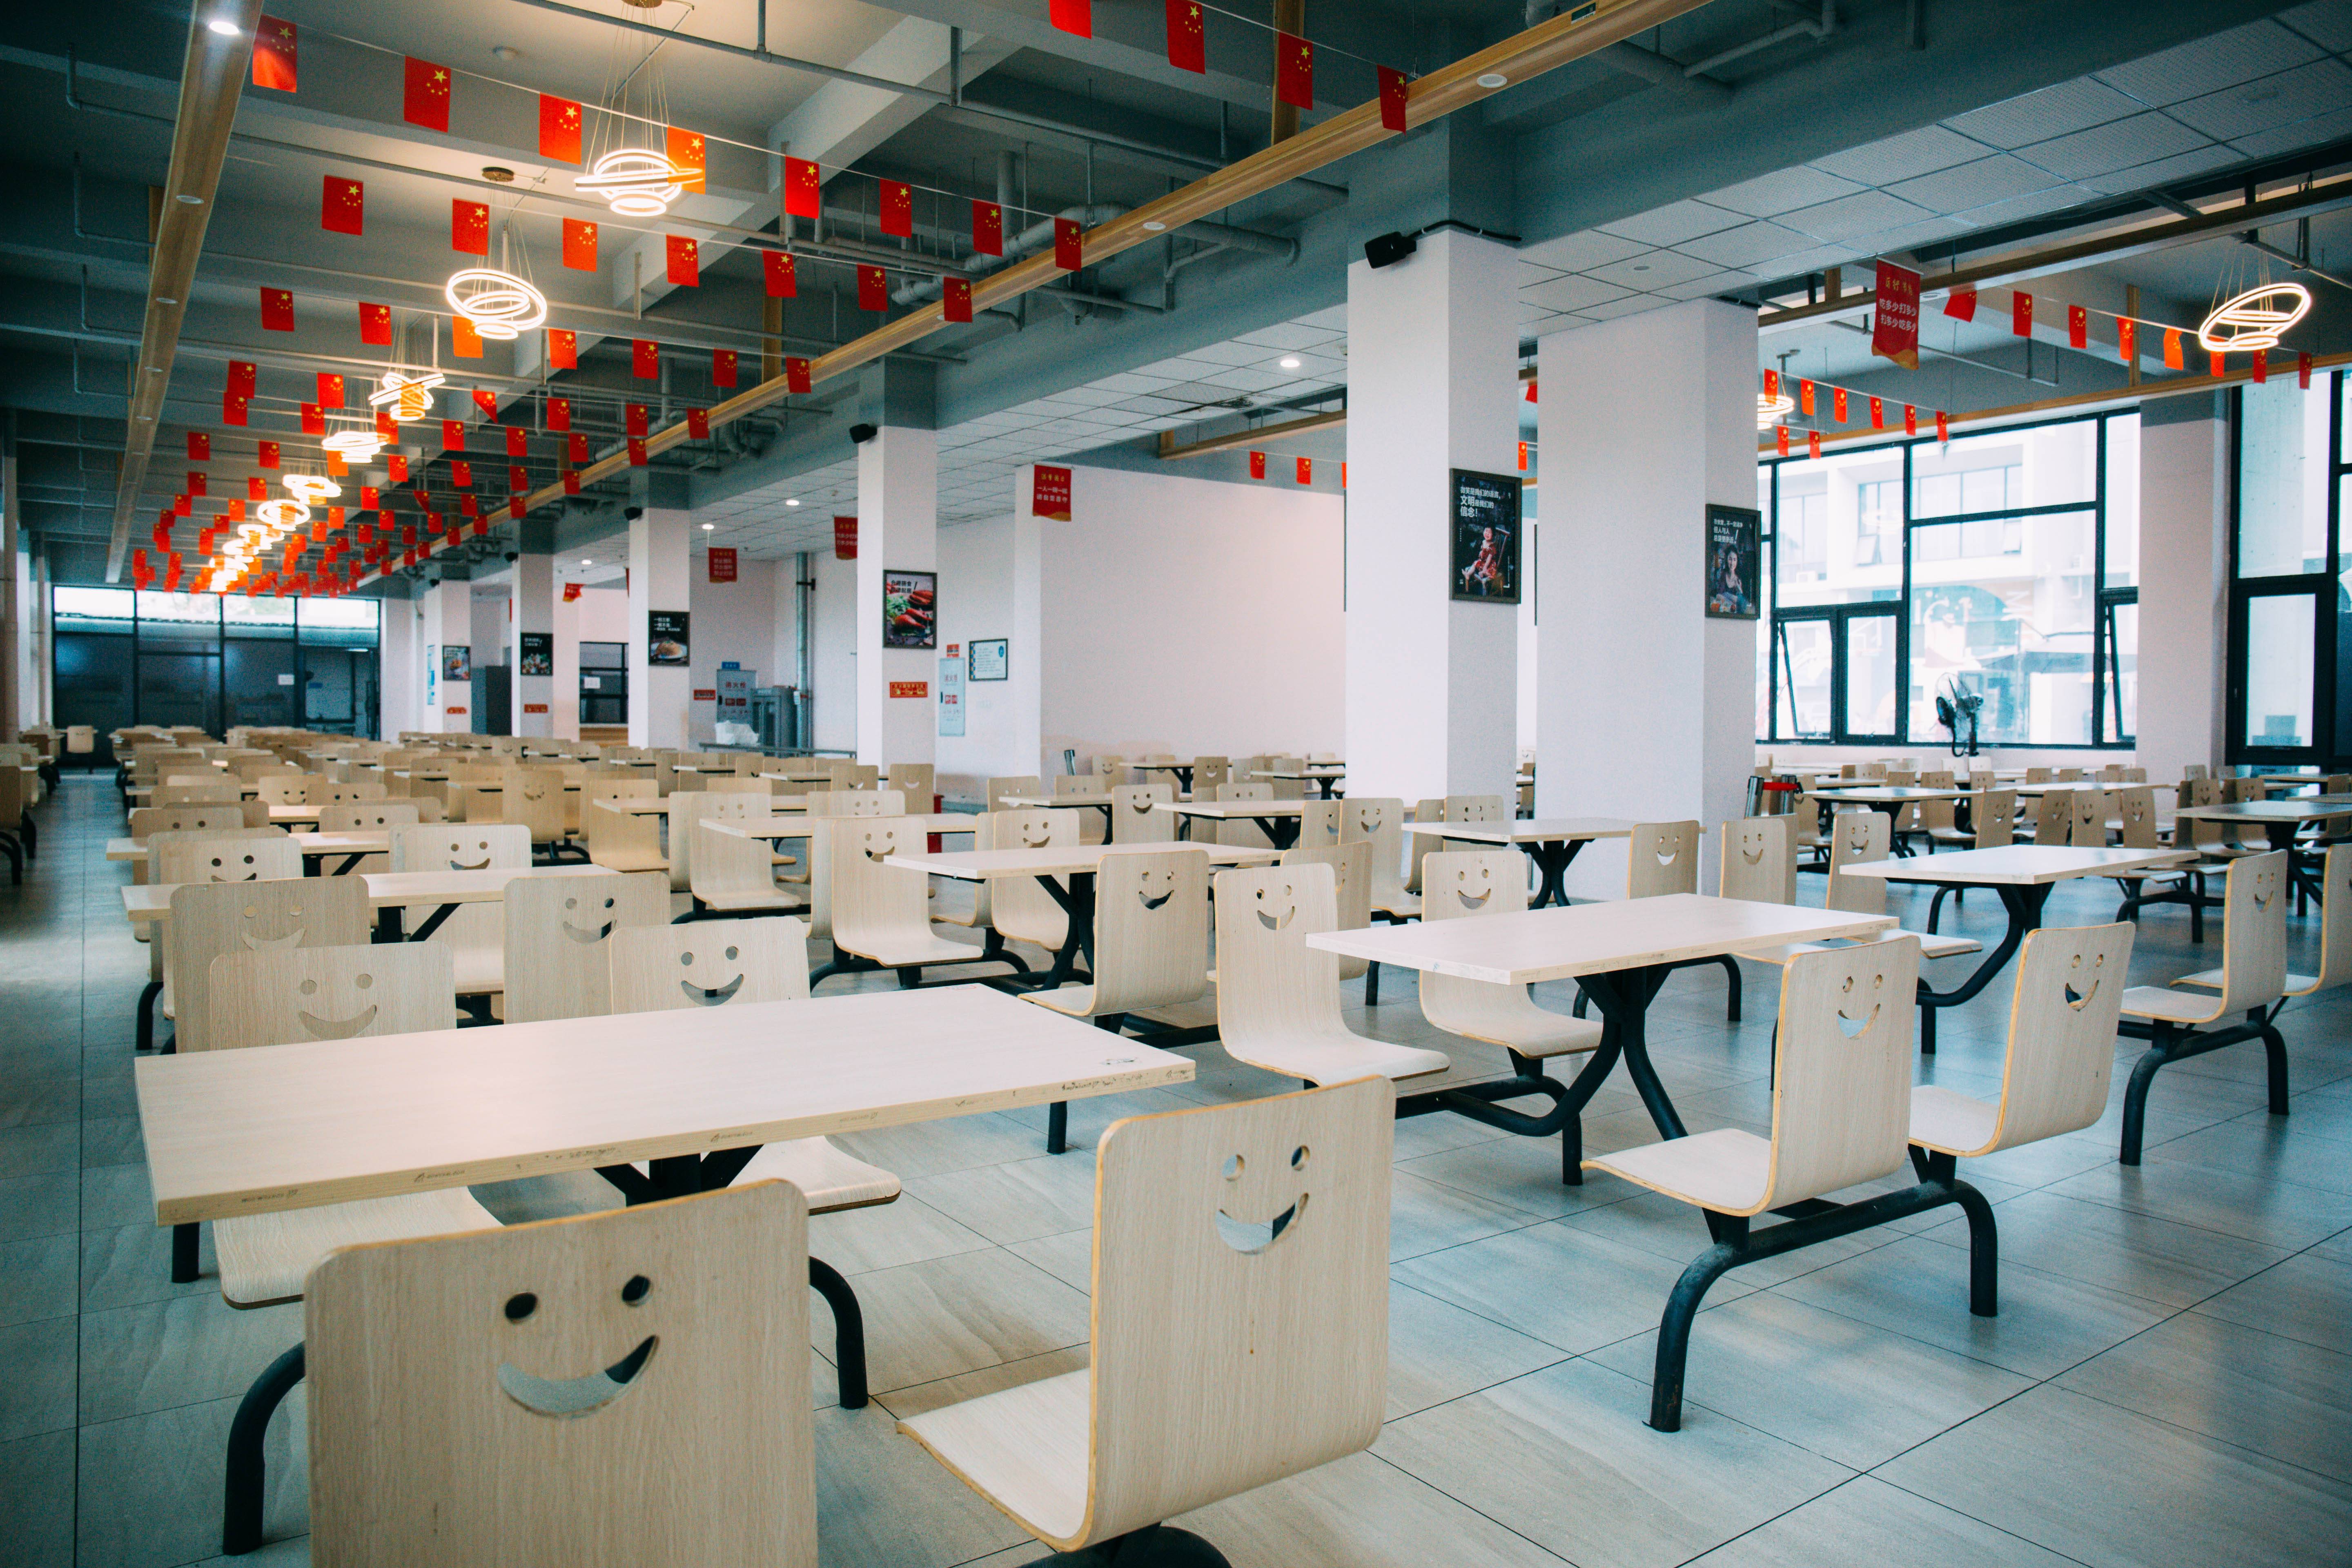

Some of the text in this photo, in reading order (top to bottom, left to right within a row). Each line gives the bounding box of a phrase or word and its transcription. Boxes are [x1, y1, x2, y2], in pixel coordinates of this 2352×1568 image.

[1879, 298, 1917, 316] 吃多少打多少
[1881, 314, 1916, 332] 打多少吃多少
[1460, 494, 1494, 509] 文明是我们的
